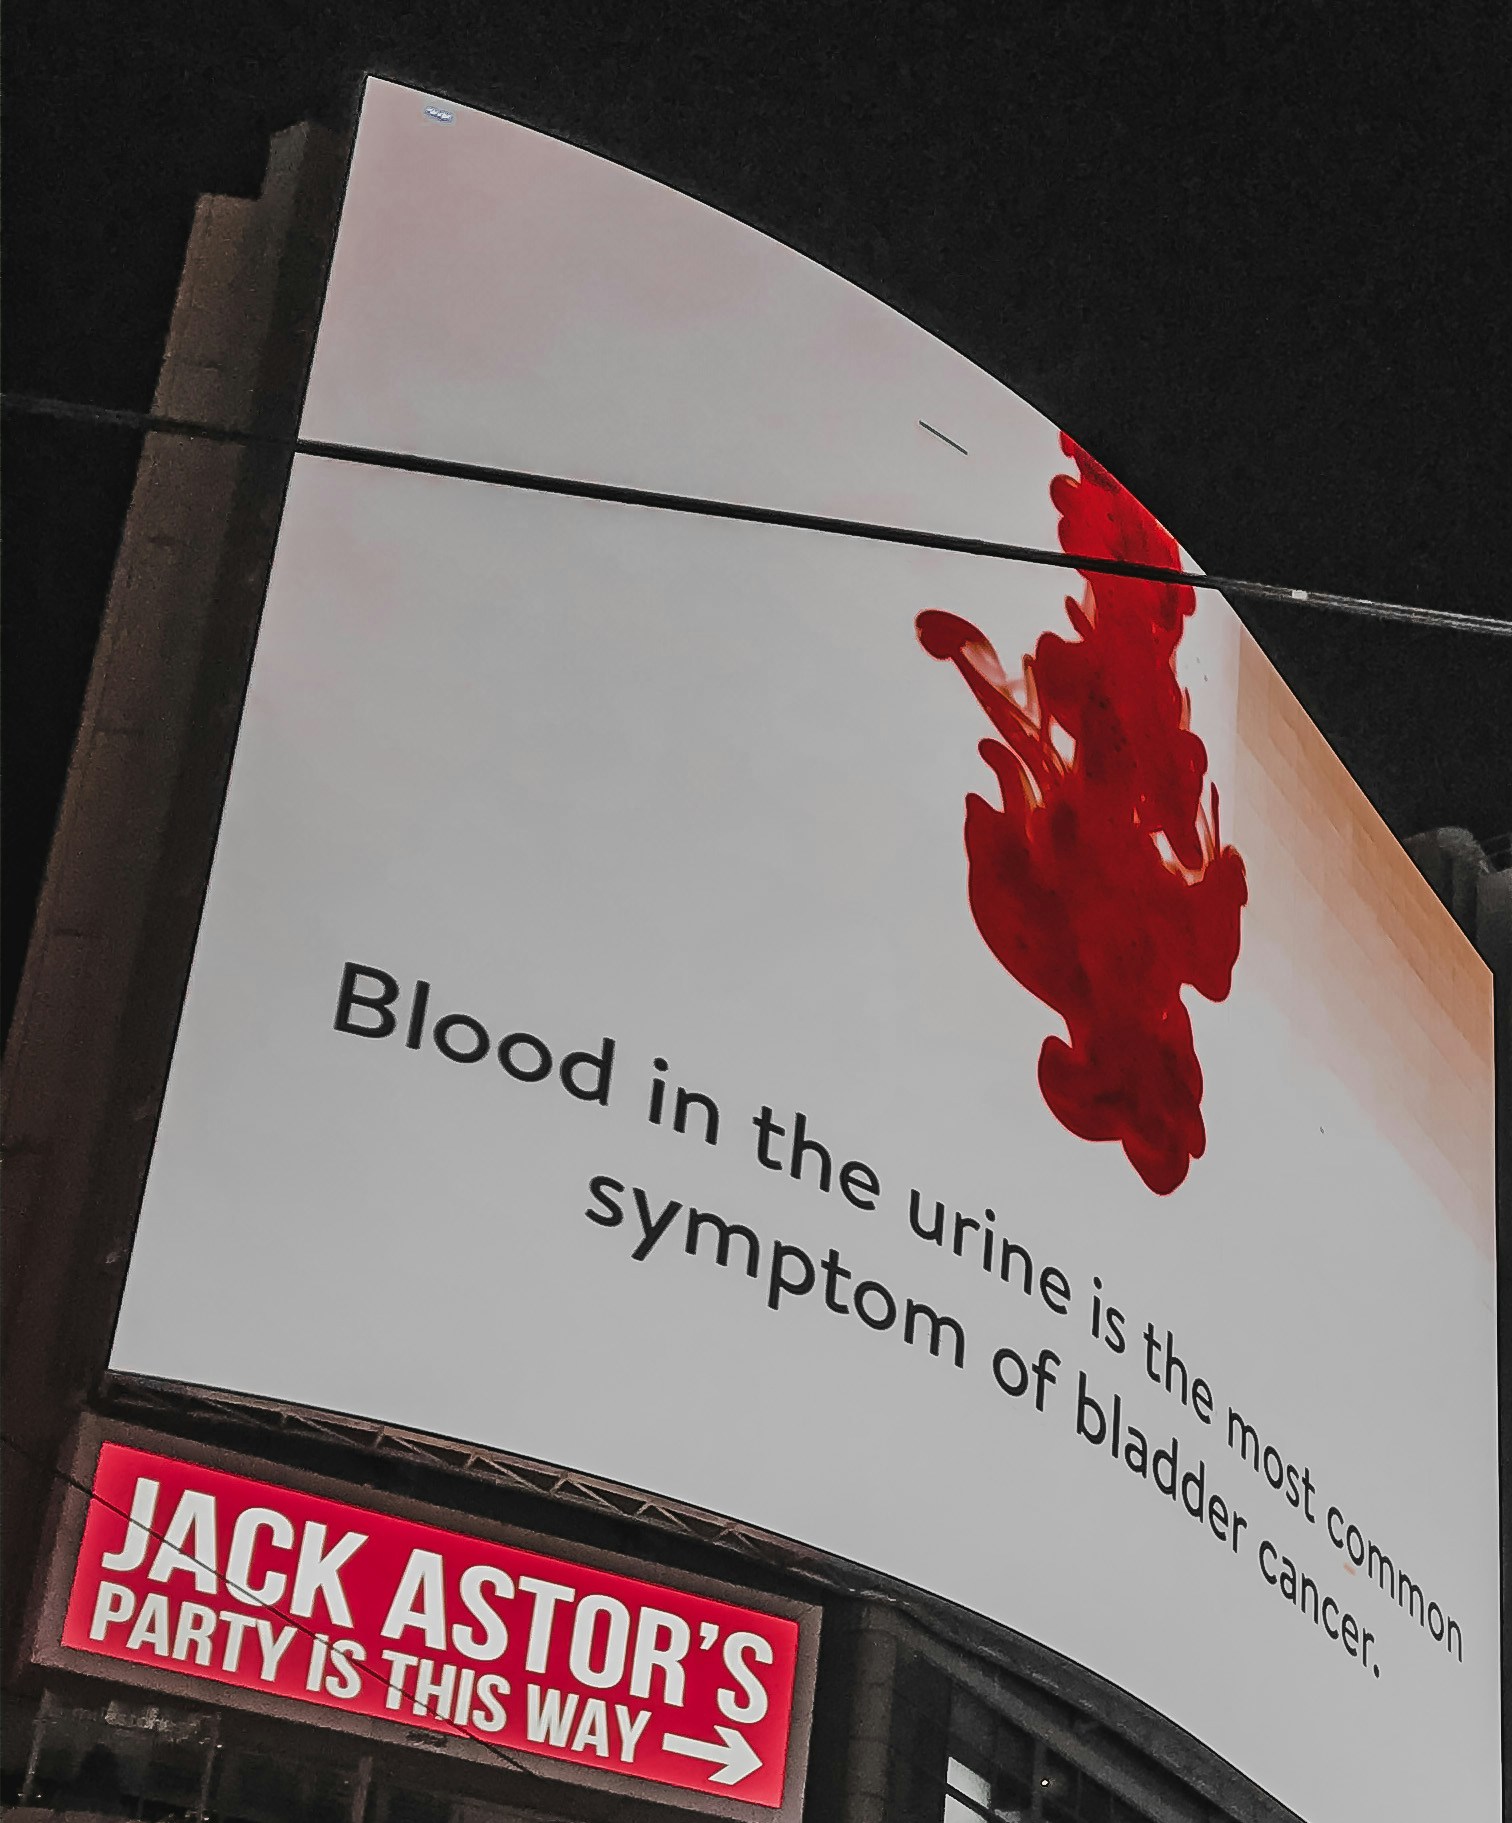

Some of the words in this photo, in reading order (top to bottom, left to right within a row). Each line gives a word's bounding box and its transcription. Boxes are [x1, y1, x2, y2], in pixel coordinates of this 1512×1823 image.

[333, 961, 616, 1107] Blood
[648, 1056, 720, 1146] in
[752, 1105, 882, 1212] the
[909, 1188, 1071, 1315] urine
[1091, 1275, 1126, 1354] is
[1143, 1322, 1213, 1425] the
[1228, 1405, 1316, 1525] most
[1327, 1506, 1464, 1663] common
[584, 1174, 966, 1369] symptom
[992, 1348, 1061, 1412] of
[1076, 1371, 1248, 1554] bladder
[1258, 1539, 1380, 1678] cancer.
[89, 1580, 297, 1682] PARTY
[305, 1633, 367, 1699] IS
[382, 1650, 511, 1733] THIS
[526, 1683, 652, 1764] WAY
[101, 1477, 369, 1628] JACK
[380, 1547, 774, 1725] ASTOR'S
